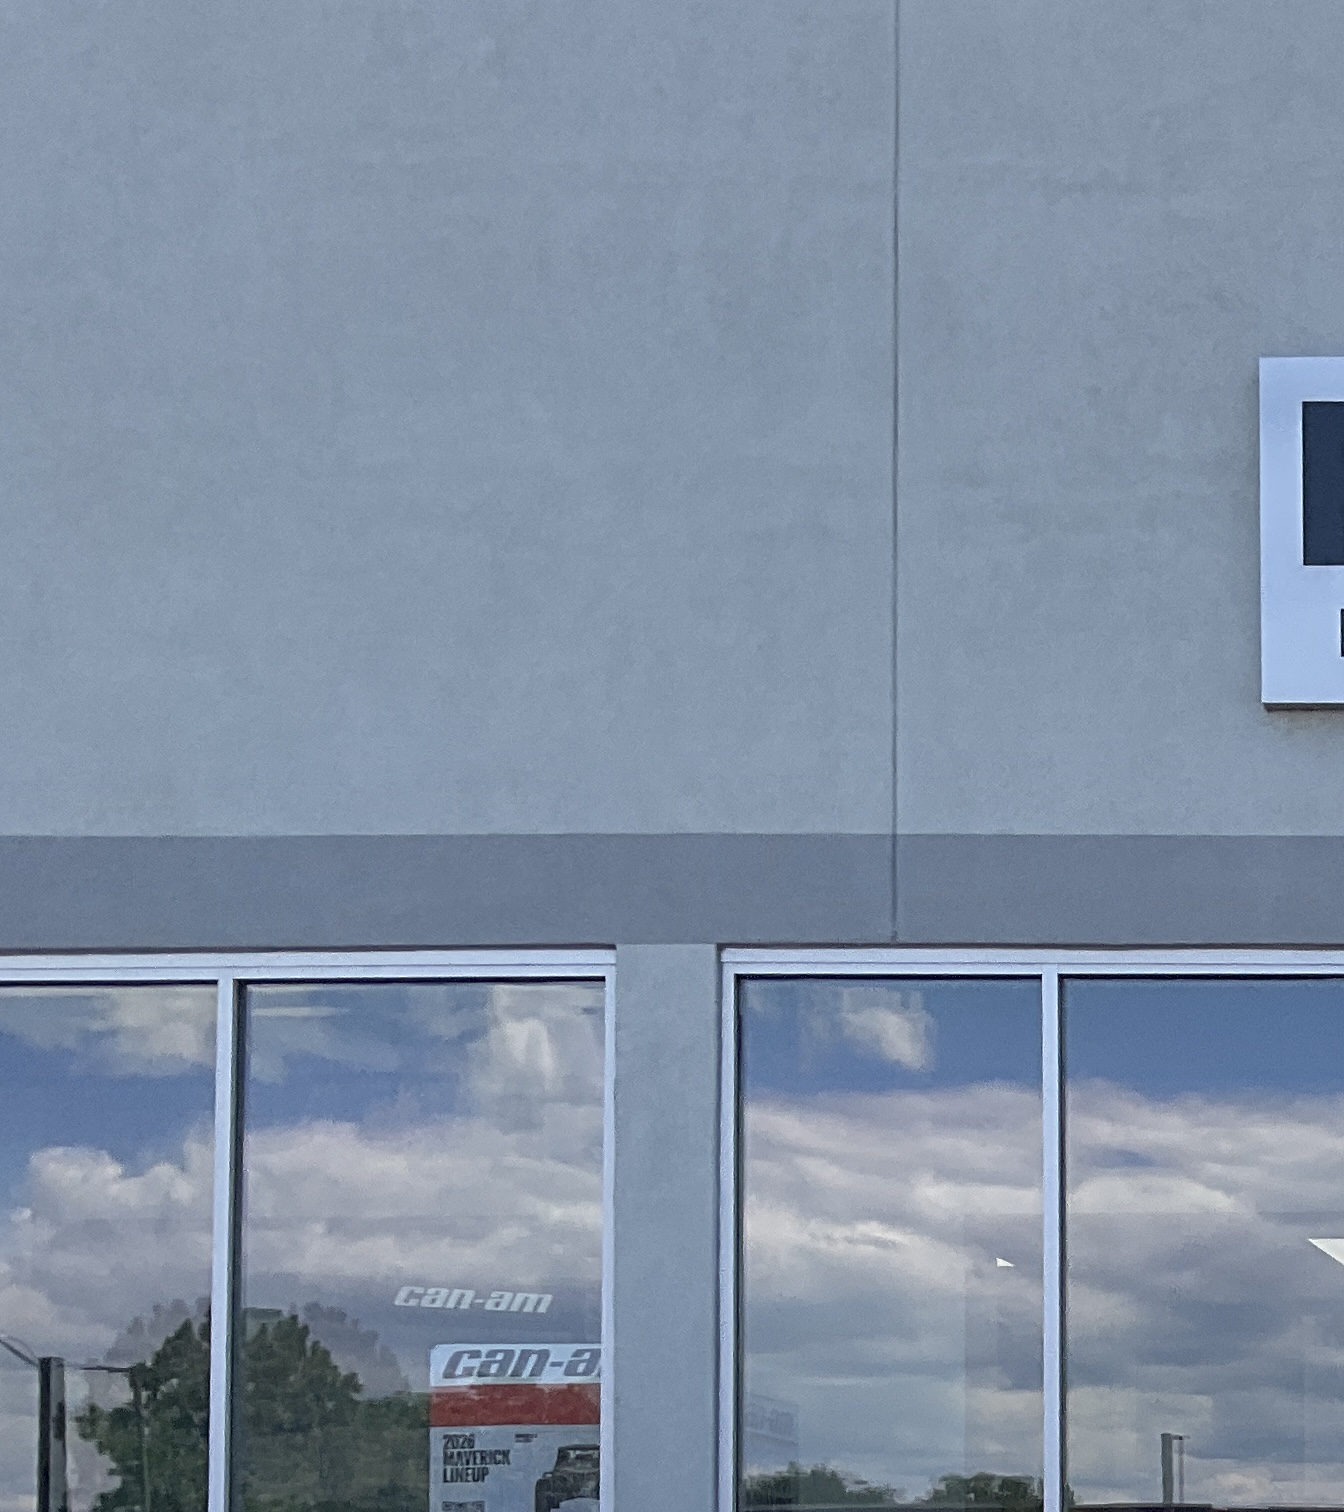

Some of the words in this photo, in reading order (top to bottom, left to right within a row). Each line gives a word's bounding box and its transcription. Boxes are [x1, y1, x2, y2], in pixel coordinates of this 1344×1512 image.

[394, 1286, 553, 1313] can-am
[442, 1348, 601, 1379] can-a
[442, 1449, 511, 1466] MAVERICK
[442, 1467, 489, 1483] LINEUP
